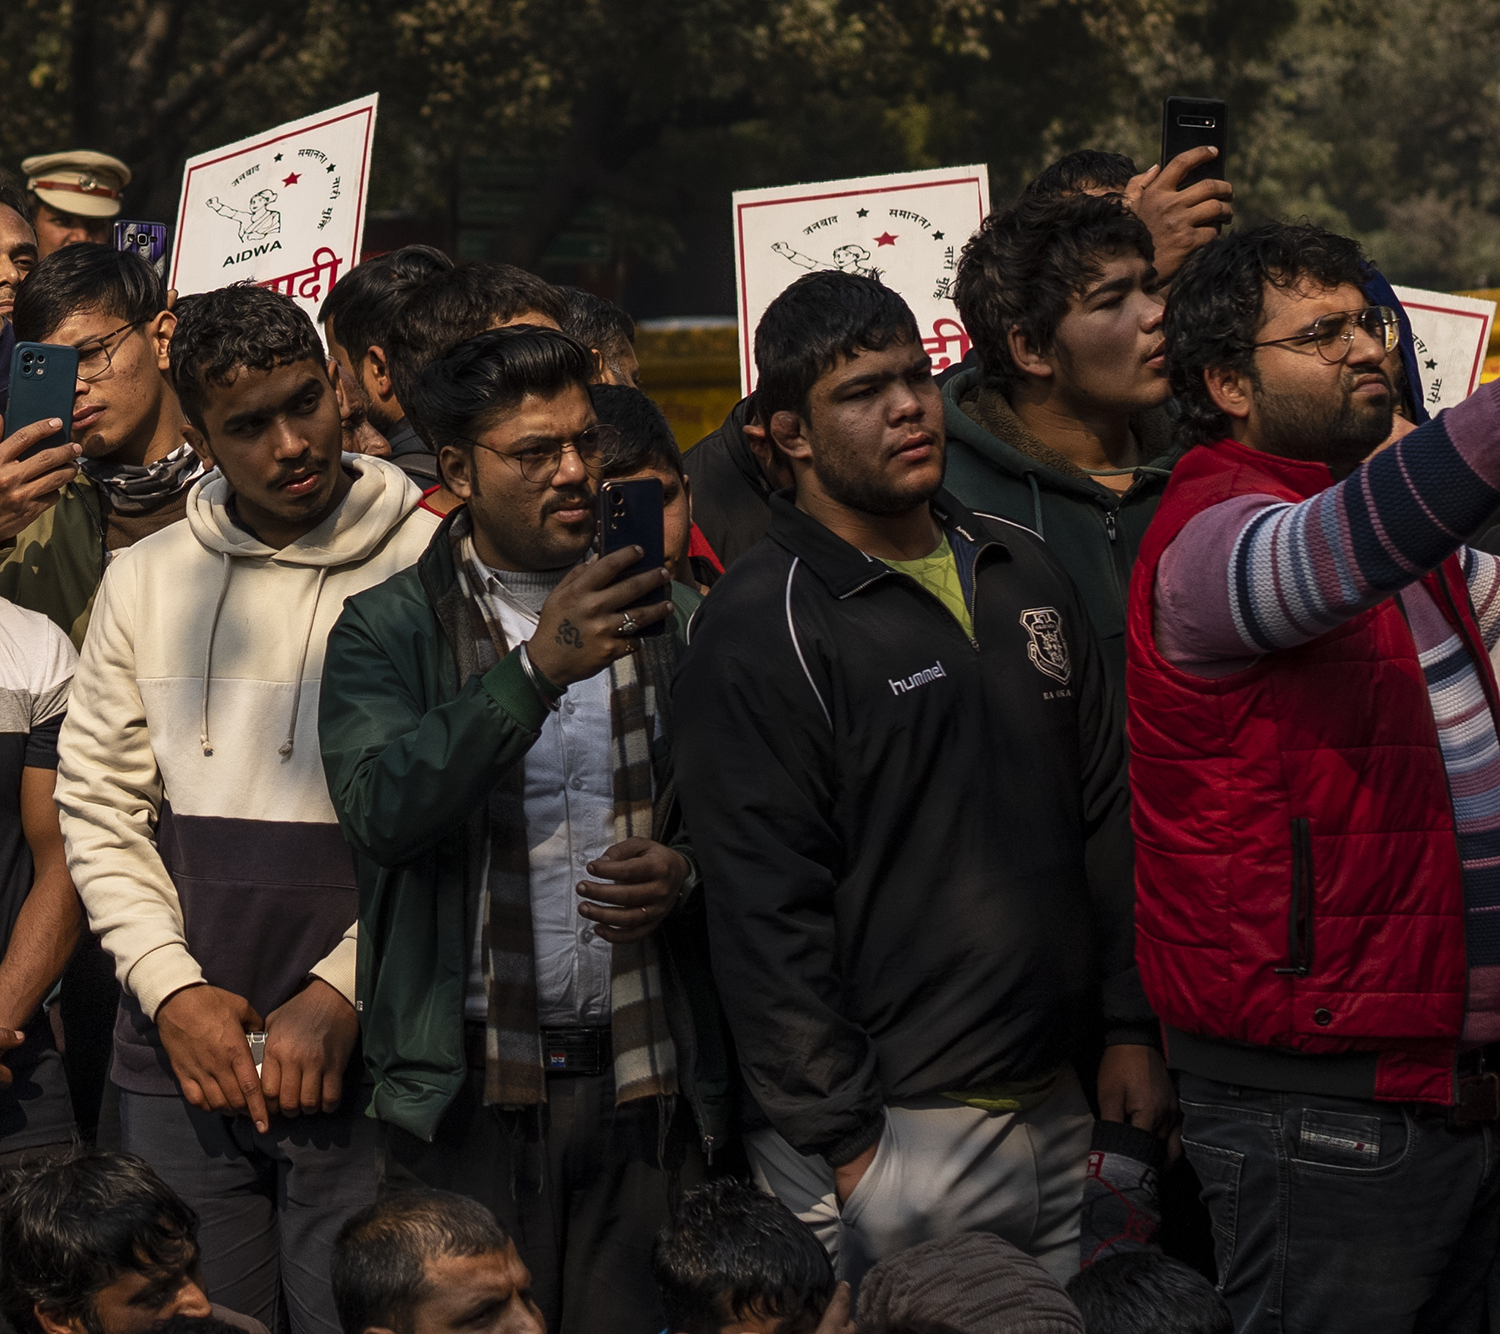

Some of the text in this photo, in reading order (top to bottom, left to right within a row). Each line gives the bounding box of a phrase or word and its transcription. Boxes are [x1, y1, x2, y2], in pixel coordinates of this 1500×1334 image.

[298, 148, 328, 164] समानता
[802, 215, 838, 236] जनवाद
[889, 208, 932, 230] समानता
[222, 240, 282, 268] AIDWA
[888, 660, 947, 696] hummel
